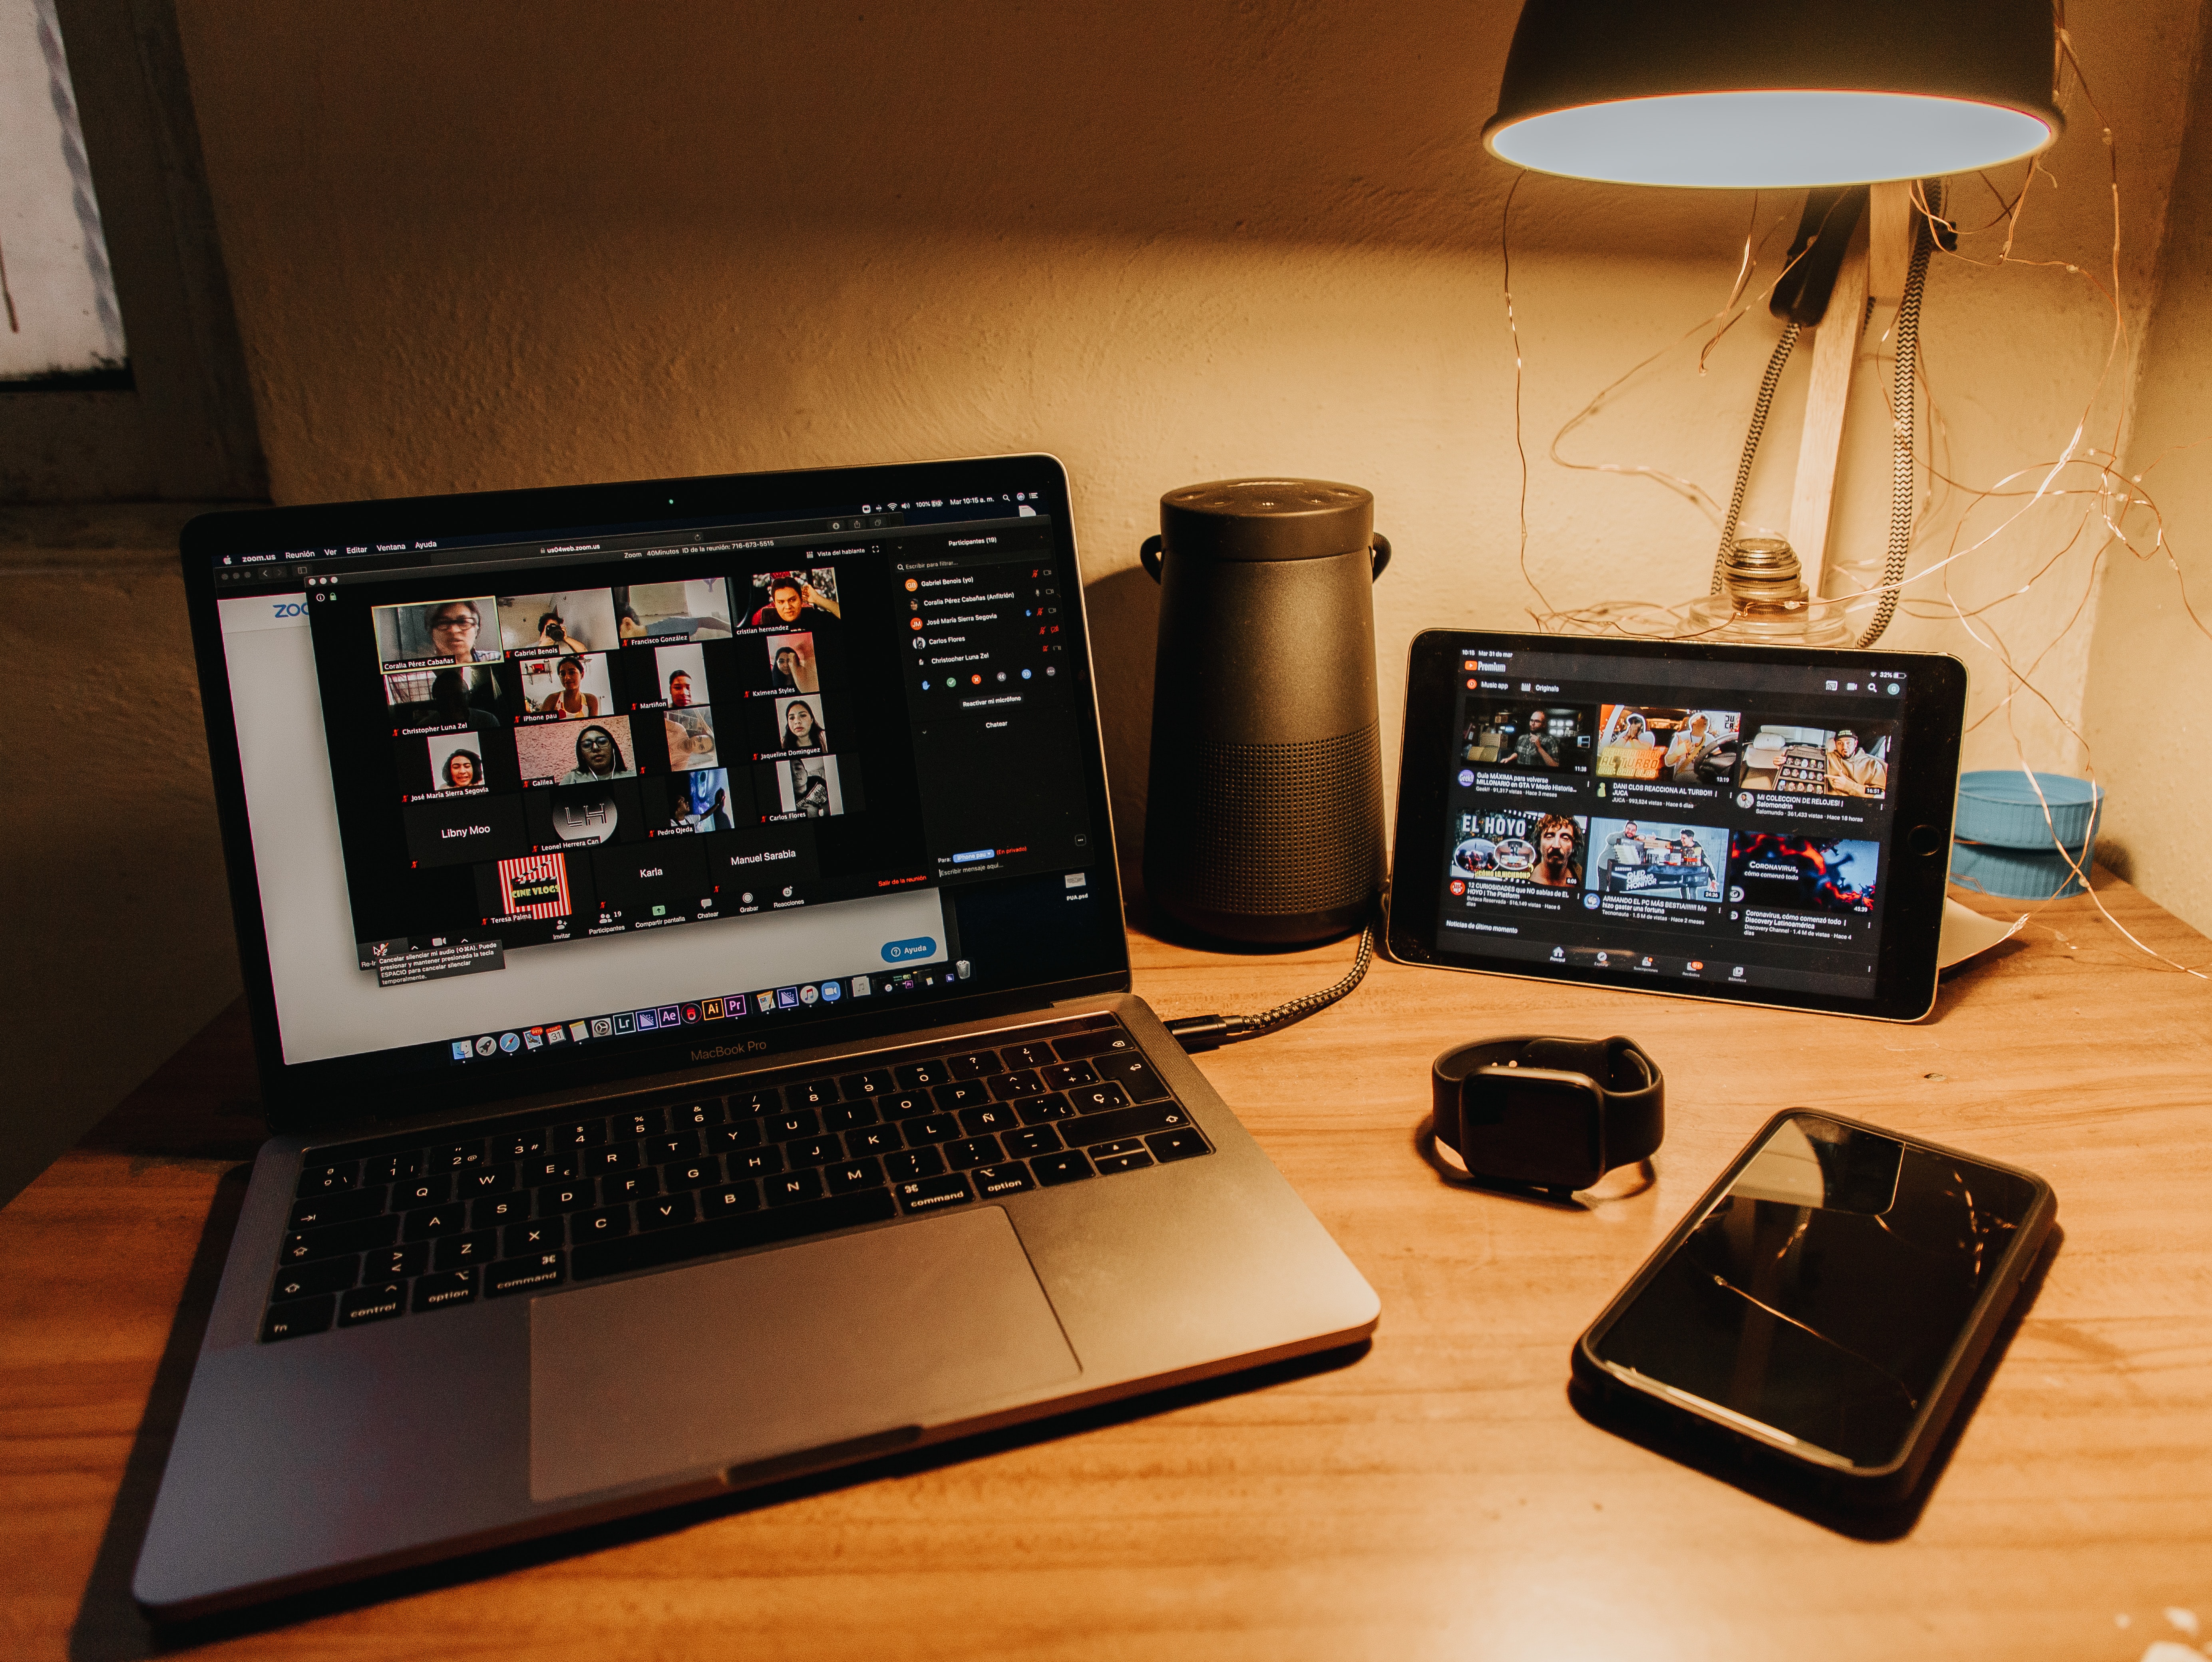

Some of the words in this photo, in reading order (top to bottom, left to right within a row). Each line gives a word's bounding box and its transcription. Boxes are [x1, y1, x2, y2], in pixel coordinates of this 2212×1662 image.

[242, 553, 276, 562] zoom.us
[285, 549, 315, 559] Reunión
[324, 548, 337, 557] Ver
[346, 545, 368, 555] Editar
[376, 542, 406, 552] Ventana
[415, 540, 438, 550] Ayuda
[547, 544, 600, 554] us04web.zoom.us
[647, 548, 679, 557] 40Minutos
[706, 543, 731, 551] reunión:
[732, 540, 774, 550] 716-673-5515
[945, 596, 961, 606] Pérez
[961, 594, 986, 603] Cabañas
[987, 592, 1014, 601] (Anfitrión)
[926, 618, 940, 626] José
[975, 613, 997, 622] Segovia
[758, 624, 789, 634] hernandez
[631, 636, 659, 646] Francisco
[660, 634, 688, 644] González
[514, 648, 537, 657] Gabriel
[537, 646, 558, 656] Benois
[384, 661, 407, 671] Coralia
[408, 659, 426, 668] Pérez
[427, 656, 454, 666] Cabañas
[1478, 661, 1506, 672] Premium
[752, 688, 777, 697] Kximena
[778, 686, 795, 695] Styles
[640, 700, 667, 709] Martiñon
[523, 714, 544, 723] iPhone
[545, 713, 557, 721] pau
[402, 725, 440, 735] Christopher
[442, 723, 456, 732] Luna
[457, 722, 467, 730] Zel
[761, 750, 787, 760] Jaqueline
[1490, 772, 1513, 781] MÁXIMA
[533, 778, 553, 787] Galilea
[1476, 779, 1510, 787] MILLONARIO
[411, 794, 425, 803] José
[426, 791, 444, 800] María
[445, 789, 463, 798] Sierra
[465, 787, 489, 796] Segovia
[1645, 786, 1678, 794] REACCIONA
[1766, 795, 1801, 803] COLECCION
[676, 825, 693, 834] Ojeda
[1462, 814, 1480, 833] EL
[1484, 816, 1526, 837] HOYO
[442, 826, 467, 839] Libny
[469, 824, 490, 835] Moo
[541, 843, 561, 852] Leonel
[586, 837, 599, 846] Can
[731, 853, 762, 866] Manuel
[764, 849, 796, 861] Sarabia
[640, 867, 663, 879] Karla
[512, 887, 531, 899] CINE
[533, 884, 559, 896] VLOGS
[1476, 883, 1515, 892] CURIOSIDADES
[1603, 895, 1633, 904] ARMANDO
[1650, 899, 1664, 907] MÁS
[1644, 905, 1665, 914] fortuna
[491, 915, 511, 924] Teresa
[513, 912, 532, 922] Palma
[1745, 916, 1773, 926] Discovery
[1774, 918, 1815, 929] Latinoamérica
[1782, 913, 1799, 921] cómo
[1800, 915, 1827, 924] comenzó
[904, 944, 927, 955] Ayuda
[708, 1003, 719, 1015] Ai
[729, 1000, 741, 1011] Pr
[662, 1010, 676, 1022] Ae
[619, 1018, 631, 1029] Lr
[691, 1043, 744, 1062] MacBook
[747, 1040, 767, 1052] Pro
[956, 1090, 965, 1099] P
[728, 1132, 738, 1140] Y
[668, 1143, 678, 1151] T
[607, 1154, 617, 1162] R
[546, 1165, 555, 1173] E
[479, 1175, 495, 1185] W
[987, 1179, 1022, 1192] option
[416, 1188, 428, 1198] Q
[910, 1191, 964, 1207] command
[497, 1270, 557, 1289] command
[428, 1288, 469, 1303] option
[350, 1302, 396, 1318] control
